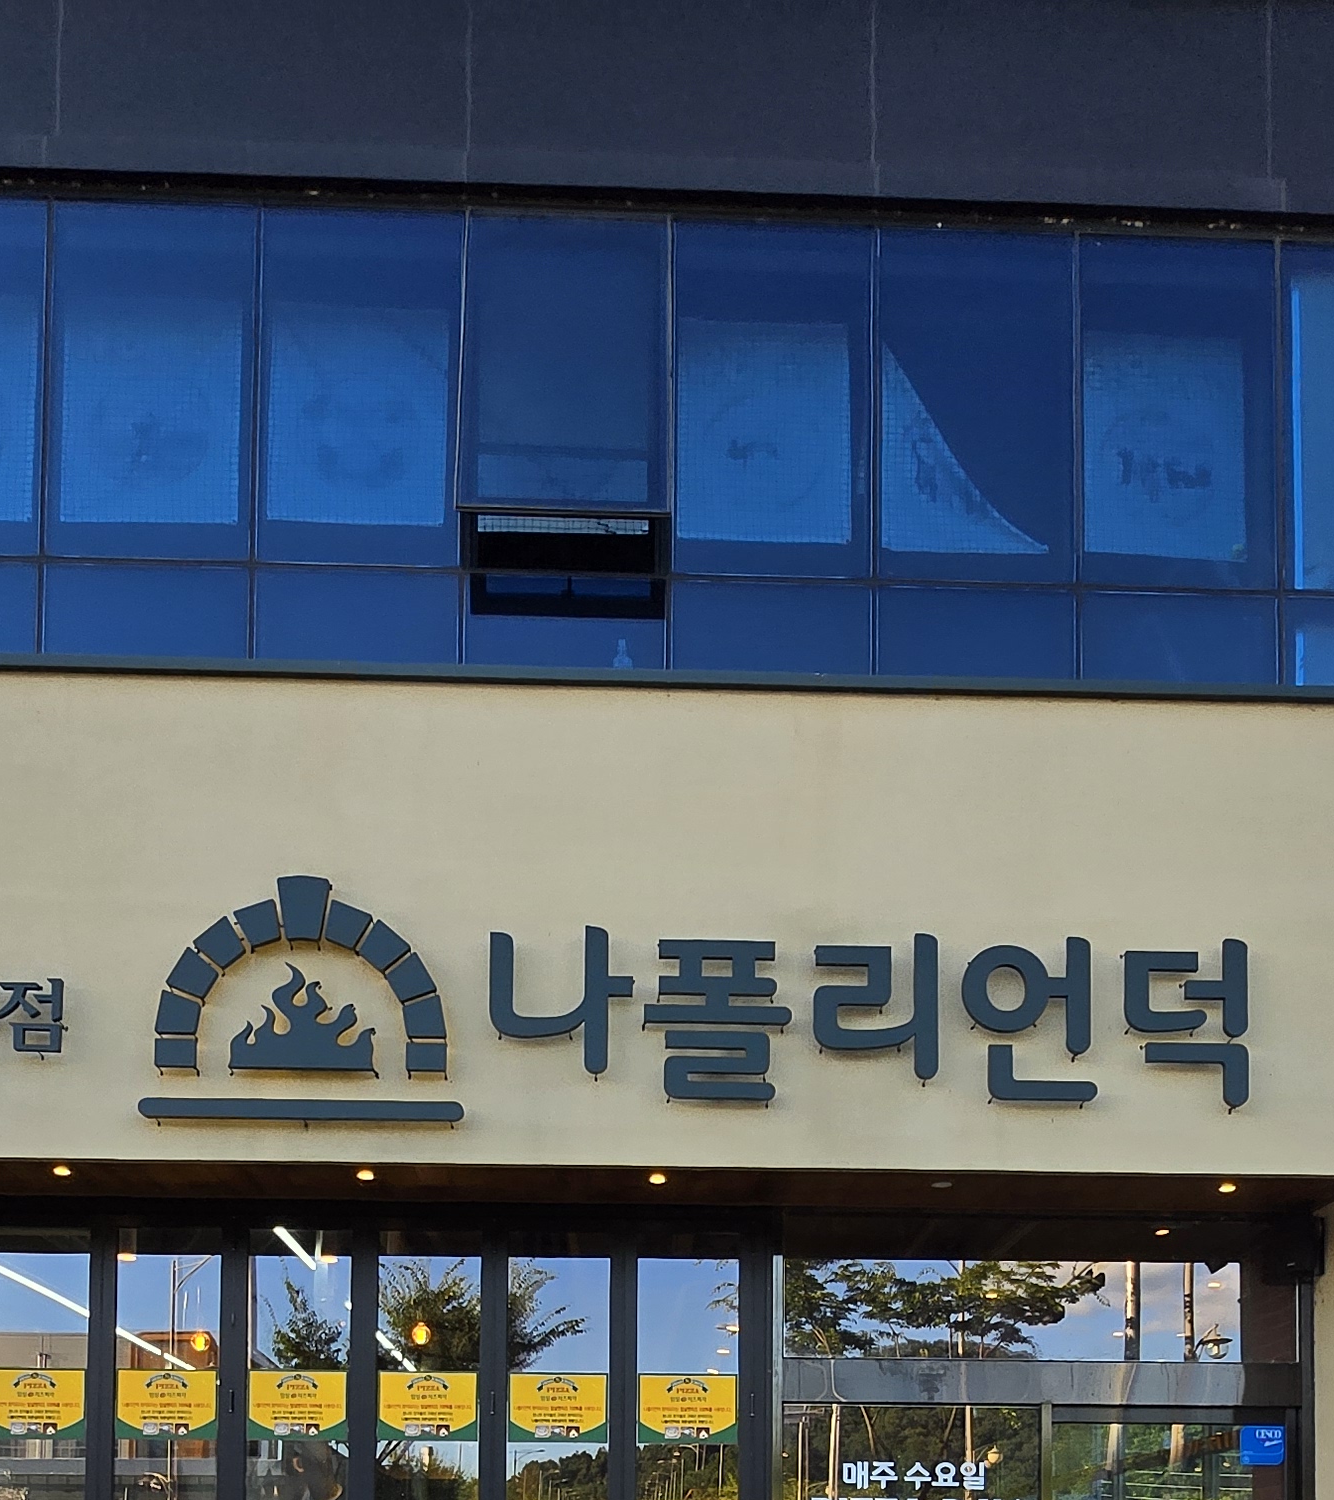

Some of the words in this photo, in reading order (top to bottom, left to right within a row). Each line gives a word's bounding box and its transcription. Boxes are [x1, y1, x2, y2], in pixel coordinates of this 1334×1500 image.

[490, 925, 1249, 1110] 나폴리언덕
[842, 1461, 898, 1489] 매주
[904, 1461, 986, 1490] 수요일
